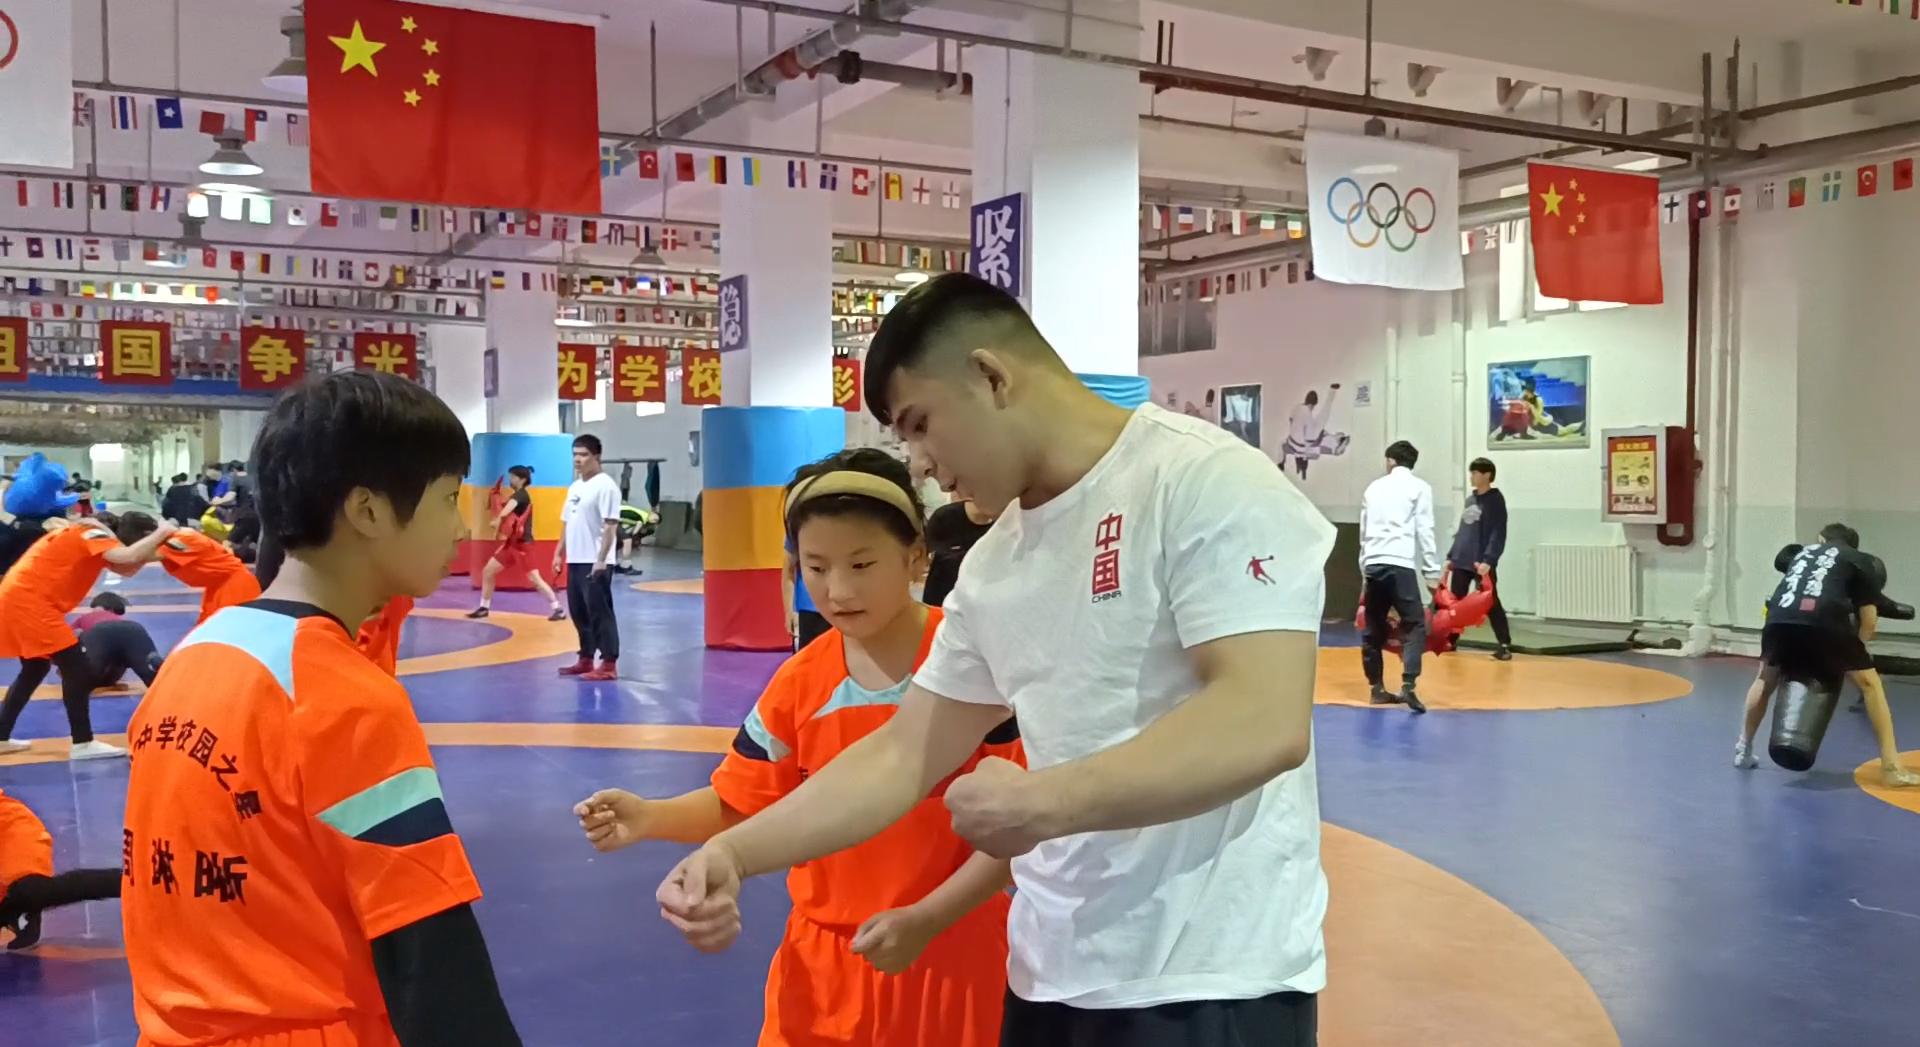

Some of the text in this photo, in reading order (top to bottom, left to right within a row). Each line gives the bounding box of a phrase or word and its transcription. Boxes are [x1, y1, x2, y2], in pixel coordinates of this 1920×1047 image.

[976, 205, 1016, 289] 紧
[1092, 513, 1122, 595] 中国
[1092, 590, 1121, 603] CHINA
[130, 716, 262, 824] 中学校园之星
